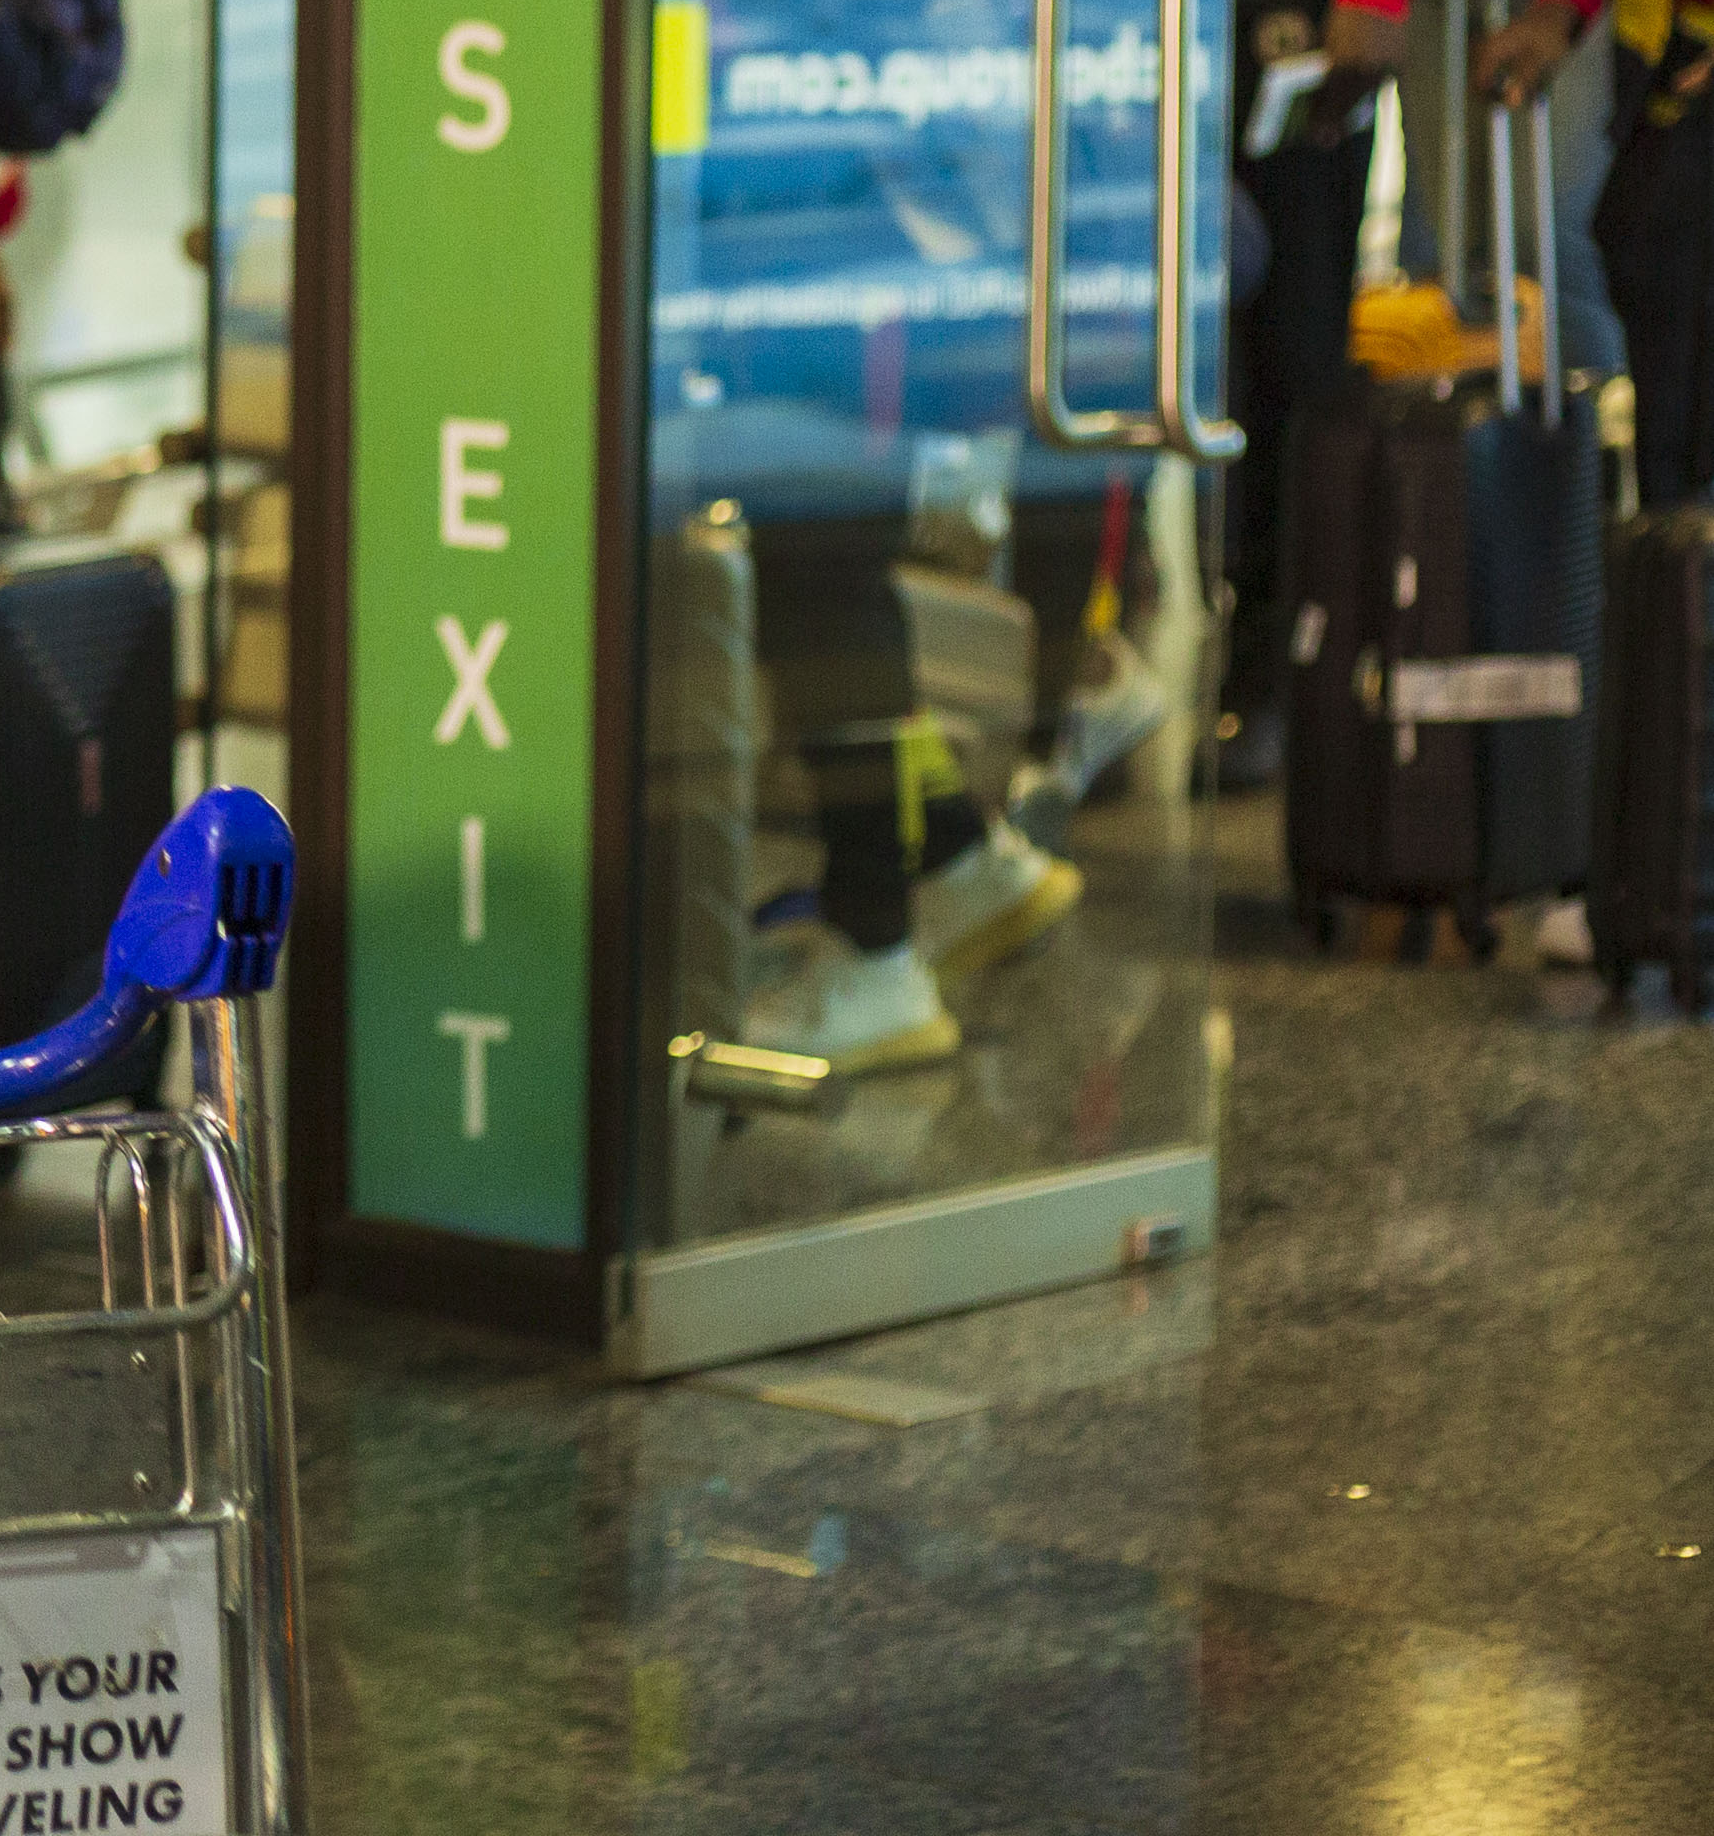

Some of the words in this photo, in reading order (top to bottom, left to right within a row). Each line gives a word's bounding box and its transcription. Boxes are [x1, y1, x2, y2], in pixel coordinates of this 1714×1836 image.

[434, 419, 511, 1140] EXIT
[21, 1649, 179, 1705] YOUR
[5, 1713, 184, 1772] SHOW
